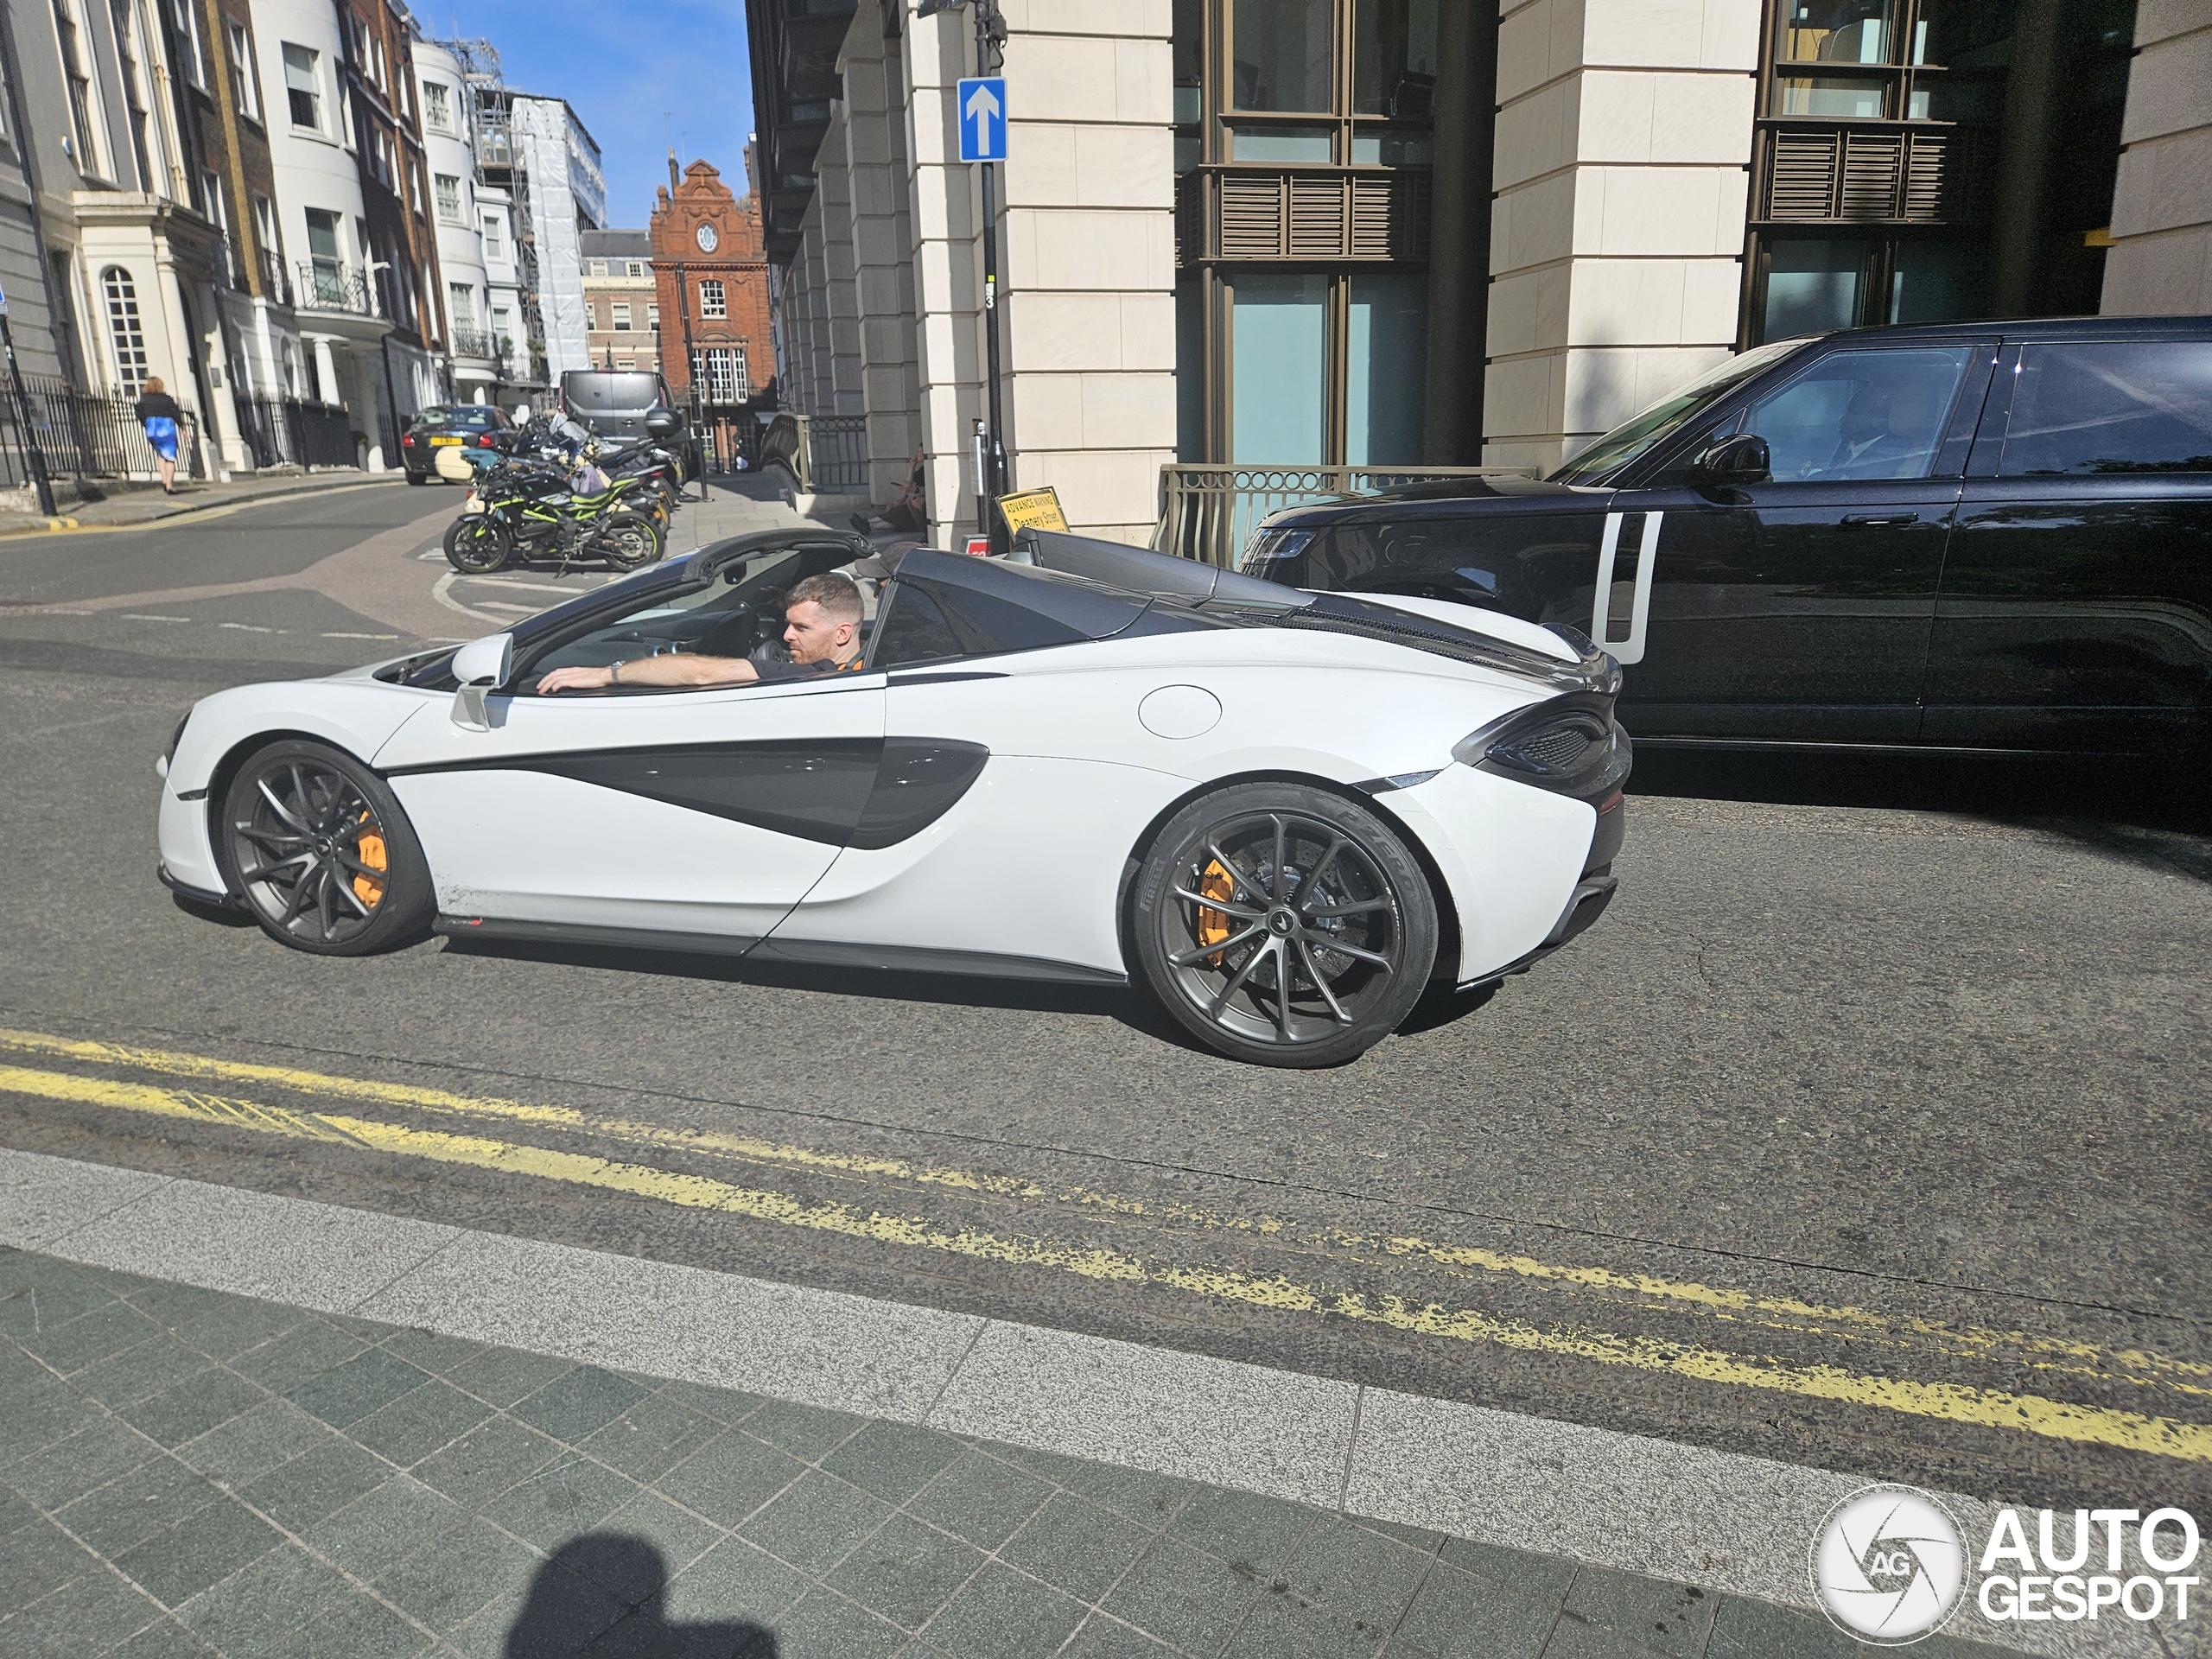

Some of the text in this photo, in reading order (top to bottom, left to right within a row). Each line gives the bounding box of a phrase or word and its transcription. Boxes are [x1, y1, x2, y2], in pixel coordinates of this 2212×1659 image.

[1006, 498, 1035, 514] ADVANCE
[1014, 510, 1059, 529] Deanery Street
[1140, 856, 1166, 912] PIRELLI
